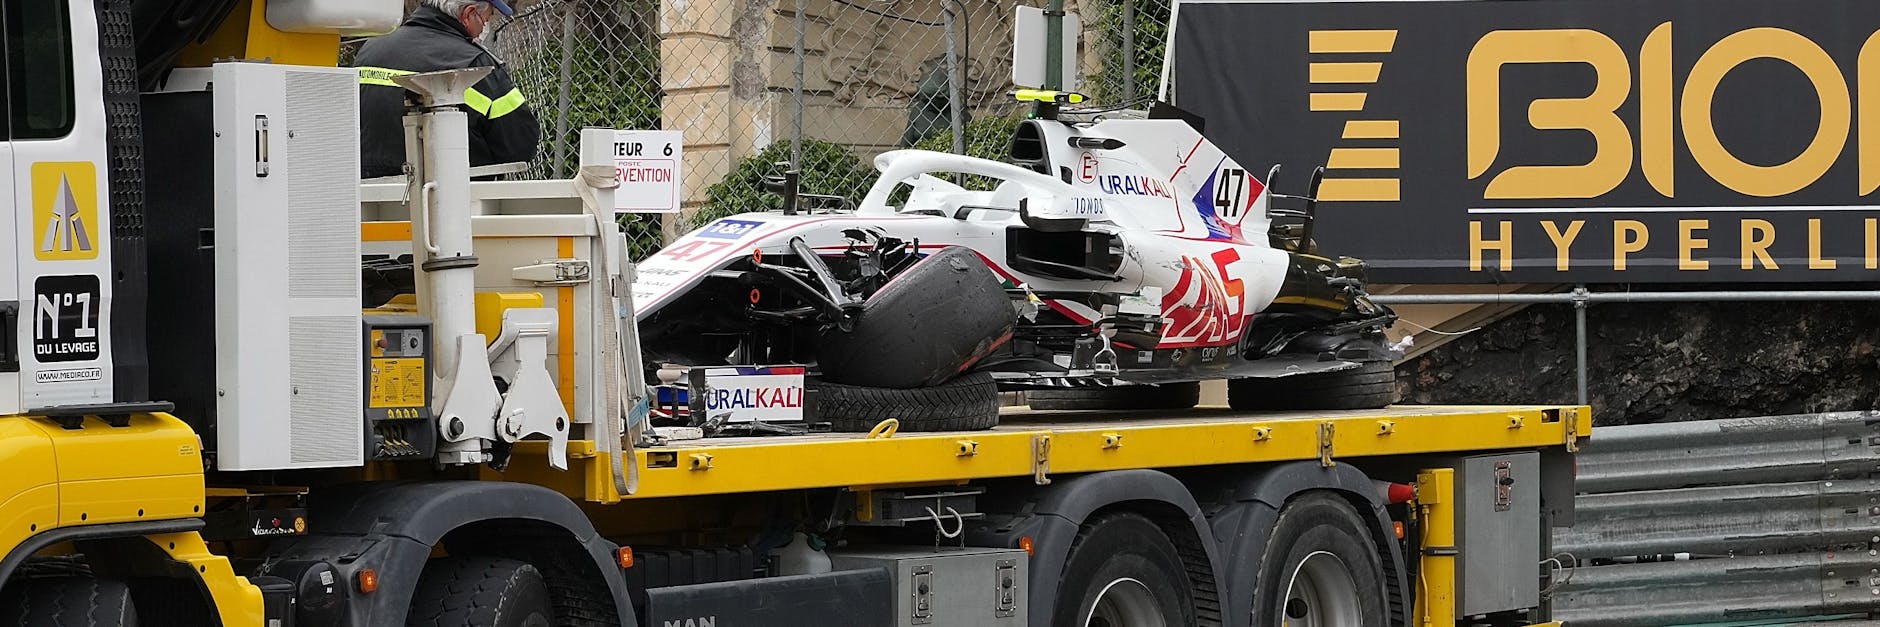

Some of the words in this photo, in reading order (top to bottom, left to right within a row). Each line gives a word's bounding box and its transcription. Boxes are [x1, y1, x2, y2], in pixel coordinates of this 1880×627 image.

[1467, 21, 1880, 199] BIO
[663, 142, 673, 157] 6
[1215, 168, 1245, 217] 47
[709, 222, 755, 235] 1&1
[661, 240, 734, 262] 47
[1468, 217, 1878, 272] HYPERLI
[37, 343, 53, 354] DU
[55, 341, 97, 354] LEVAGE
[37, 370, 100, 380] WWW.MEDIACO.FR
[706, 387, 803, 411] URALKALI
